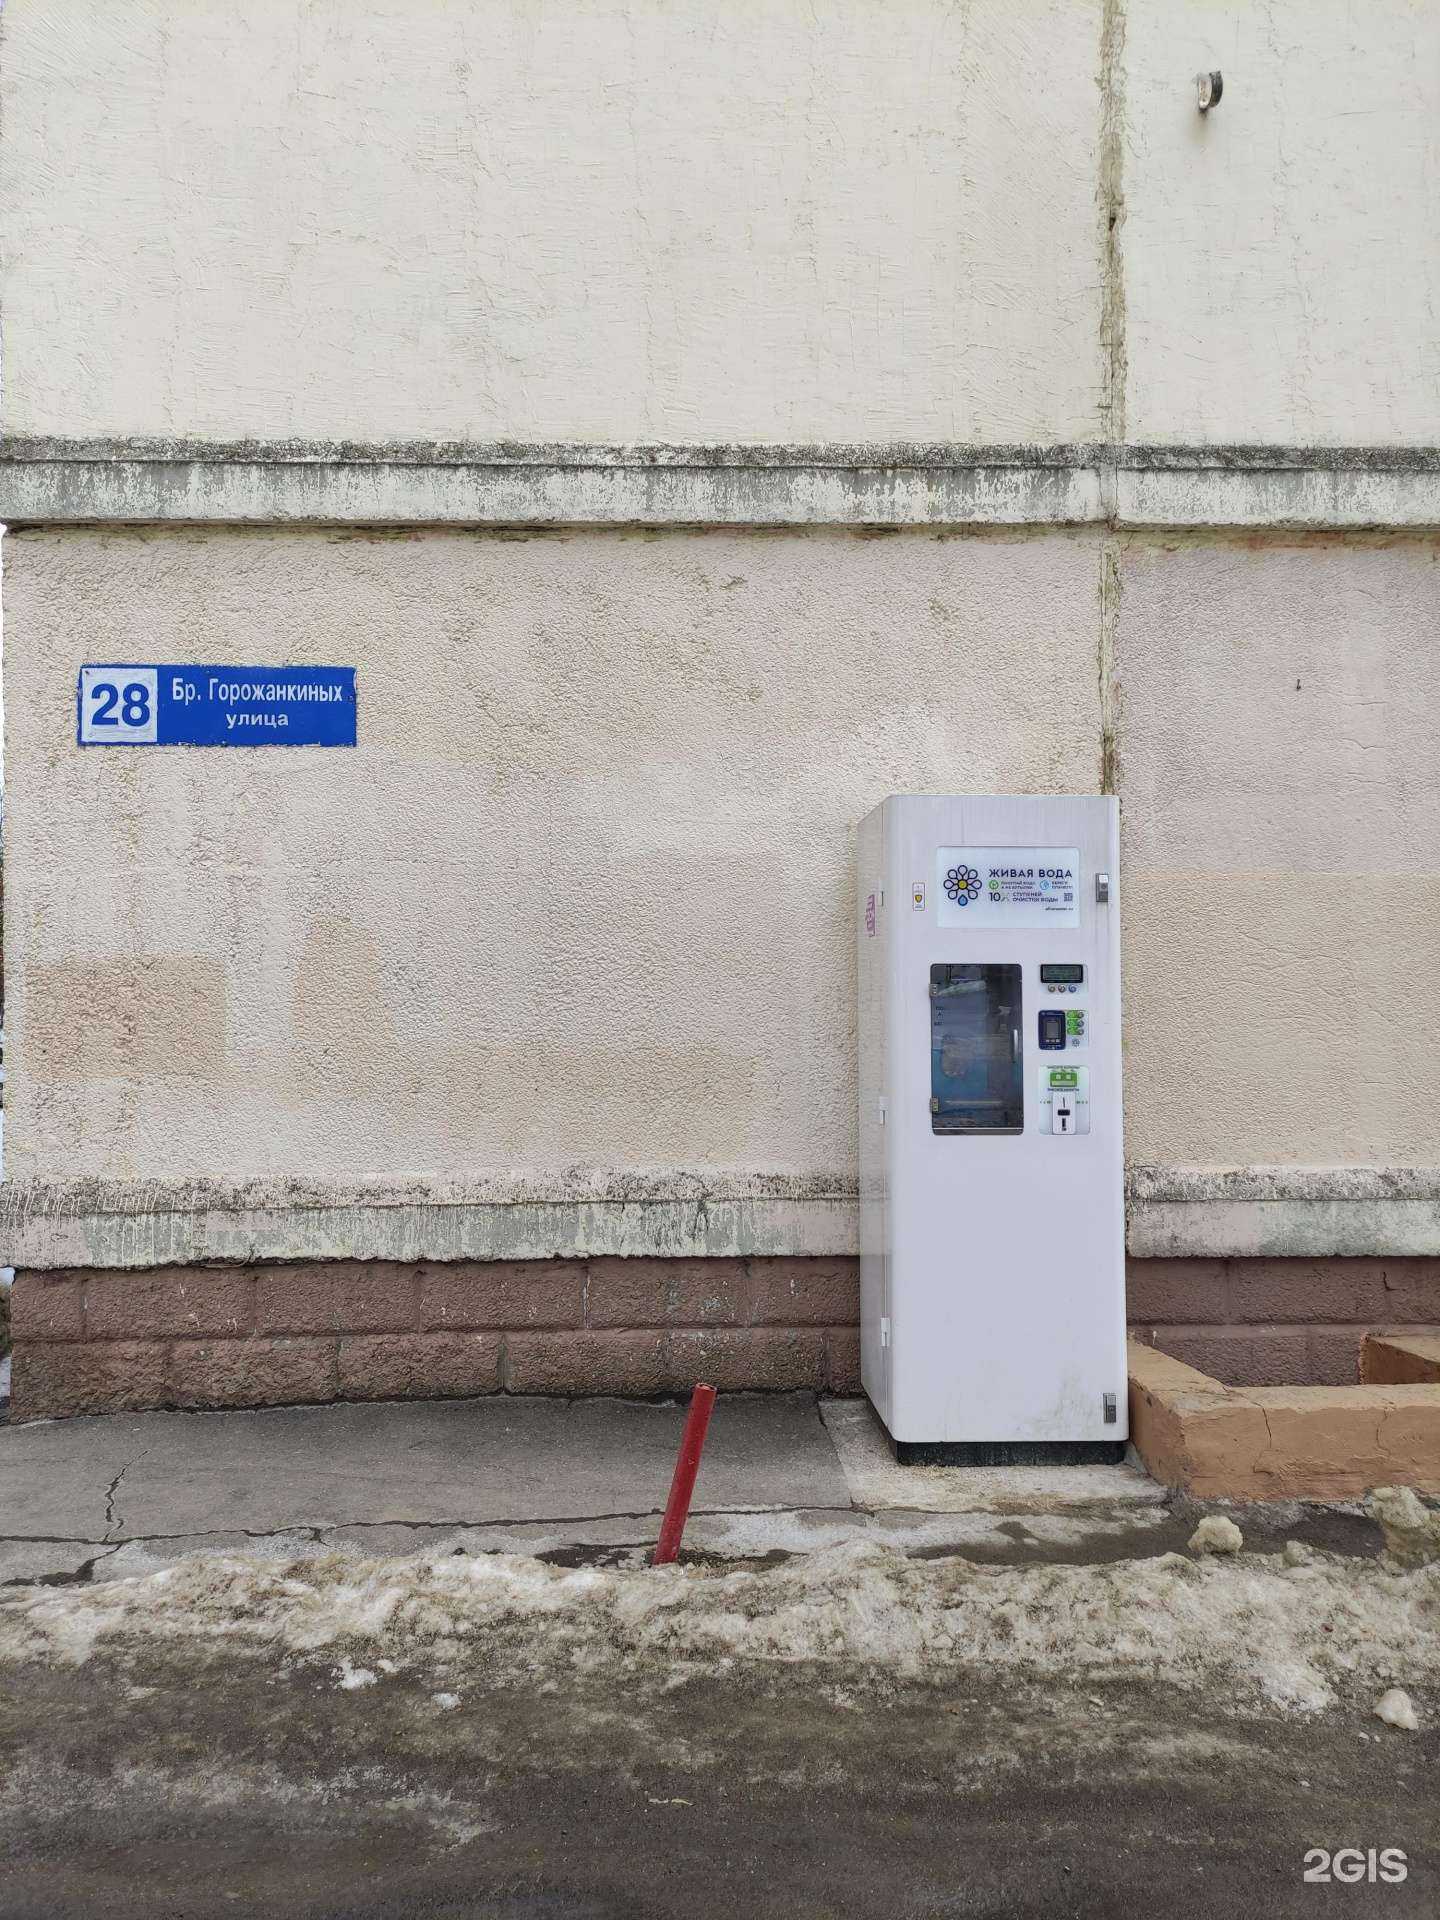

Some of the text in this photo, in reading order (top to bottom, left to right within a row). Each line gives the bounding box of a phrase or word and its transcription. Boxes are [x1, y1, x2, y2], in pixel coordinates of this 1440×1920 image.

[172, 677, 343, 705] Бр. Горожанкиных
[91, 683, 150, 727] 28
[226, 712, 289, 729] улица
[988, 868, 1073, 879] ЖИВАЯ ВОДА
[988, 892, 1001, 902] 10
